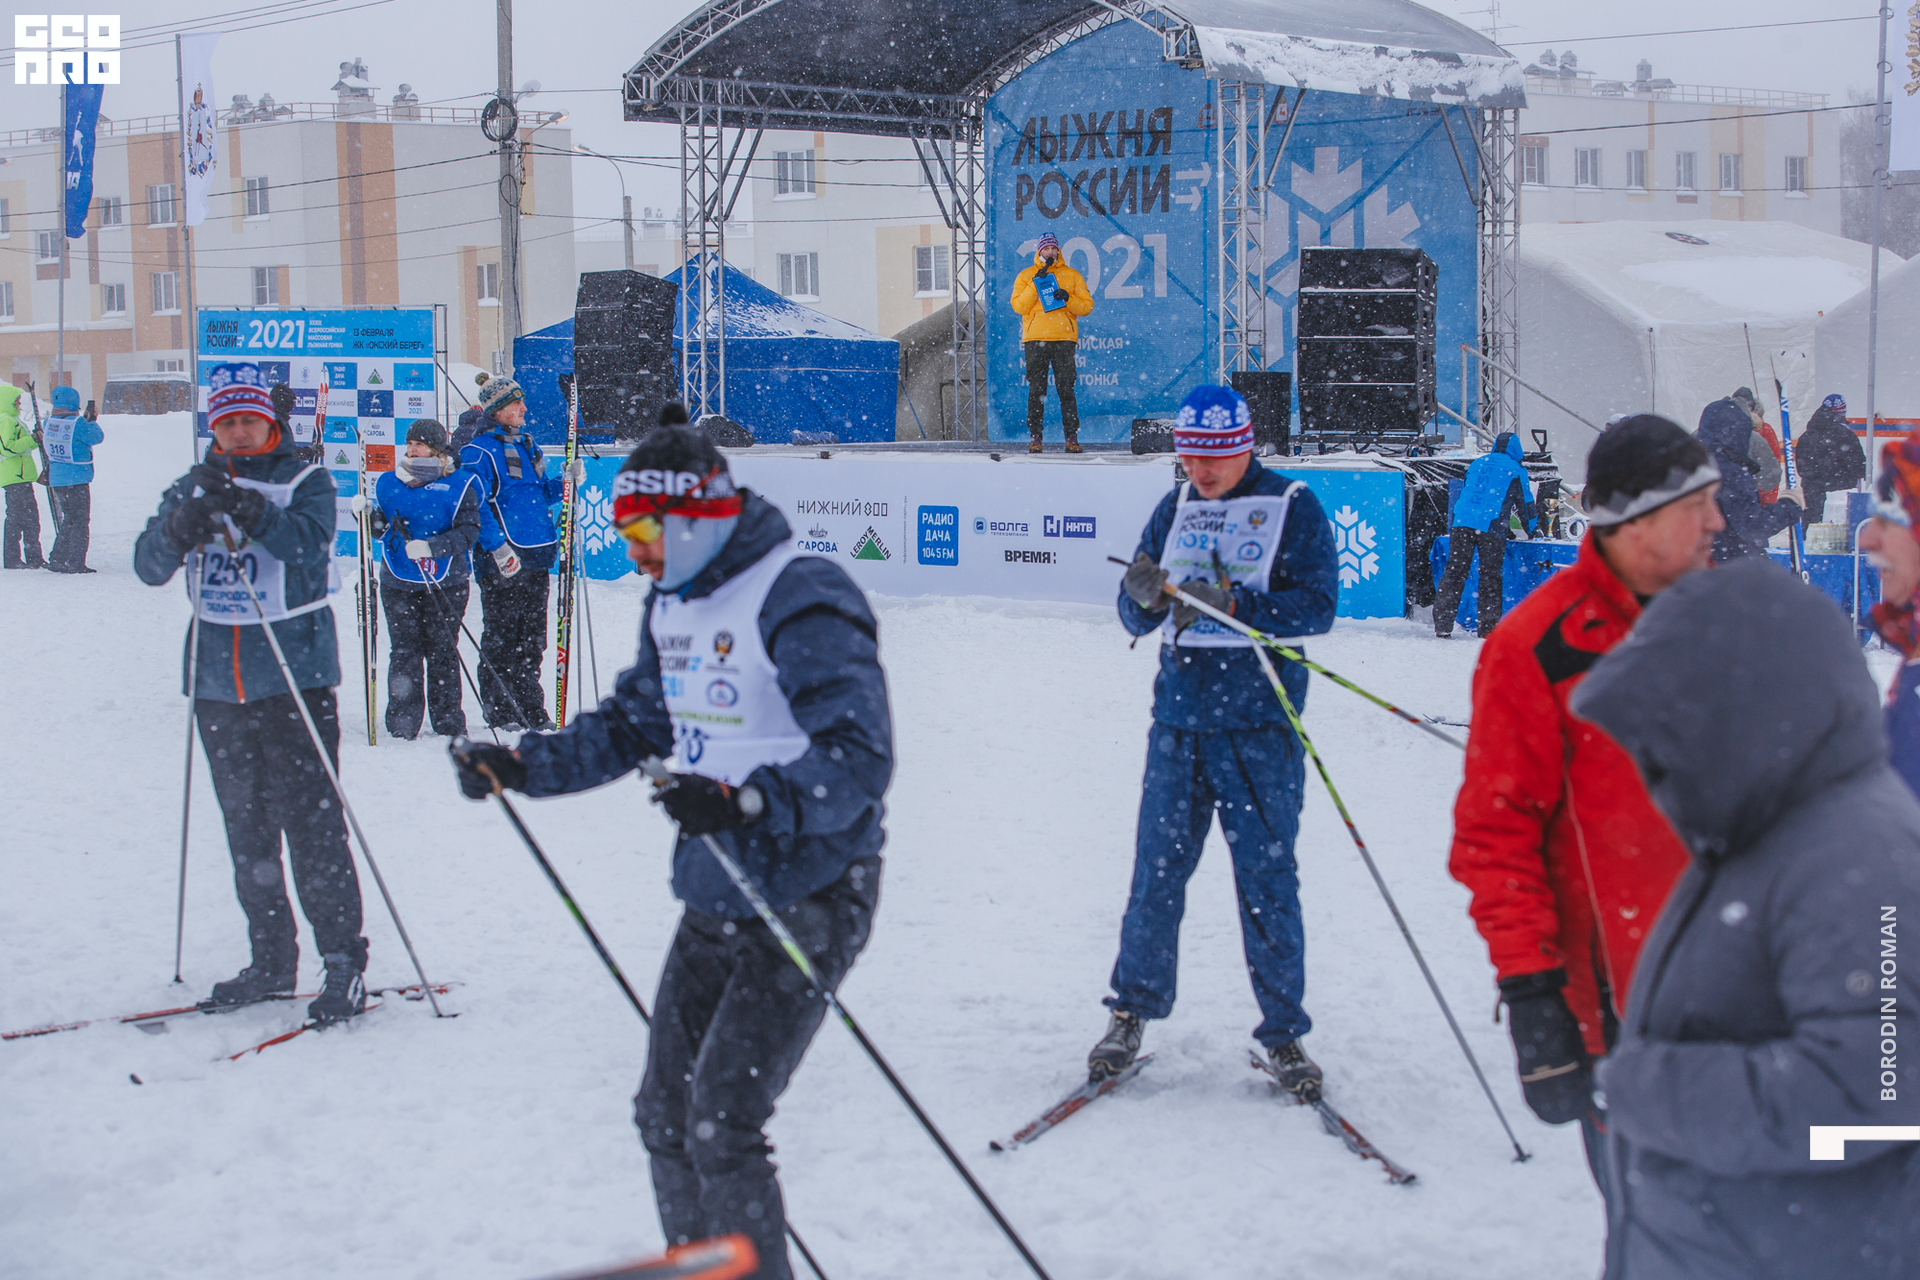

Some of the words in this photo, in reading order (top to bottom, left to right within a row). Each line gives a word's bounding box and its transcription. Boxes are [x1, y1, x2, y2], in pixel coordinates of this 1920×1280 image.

[1011, 107, 1173, 166] ЛЫЖНЯ
[1016, 164, 1171, 221] РОССИИ
[1016, 233, 1167, 299] 021
[206, 320, 239, 333] ЛЫЖНЯ
[353, 329, 360, 337] 13
[361, 328, 394, 337] ФЕВРАЛЯ
[248, 319, 305, 348] 2021
[207, 335, 238, 348] РОССИИ
[352, 341, 364, 349] ЖК
[1079, 374, 1119, 386] ГОНКА
[366, 429, 385, 437] САРОВА
[49, 443, 65, 455] 318
[1786, 438, 1797, 489] NORDWAY
[1471, 458, 1498, 505] RUSSIA
[797, 499, 862, 516] НИЖНИЙ
[922, 512, 954, 526] РАДИО
[1065, 522, 1094, 533] ННТВ
[924, 529, 951, 542] ДАЧА
[797, 540, 838, 553] САРОВА
[850, 533, 869, 558] LEROY
[866, 525, 892, 560] MERLIN
[942, 547, 955, 559] FM
